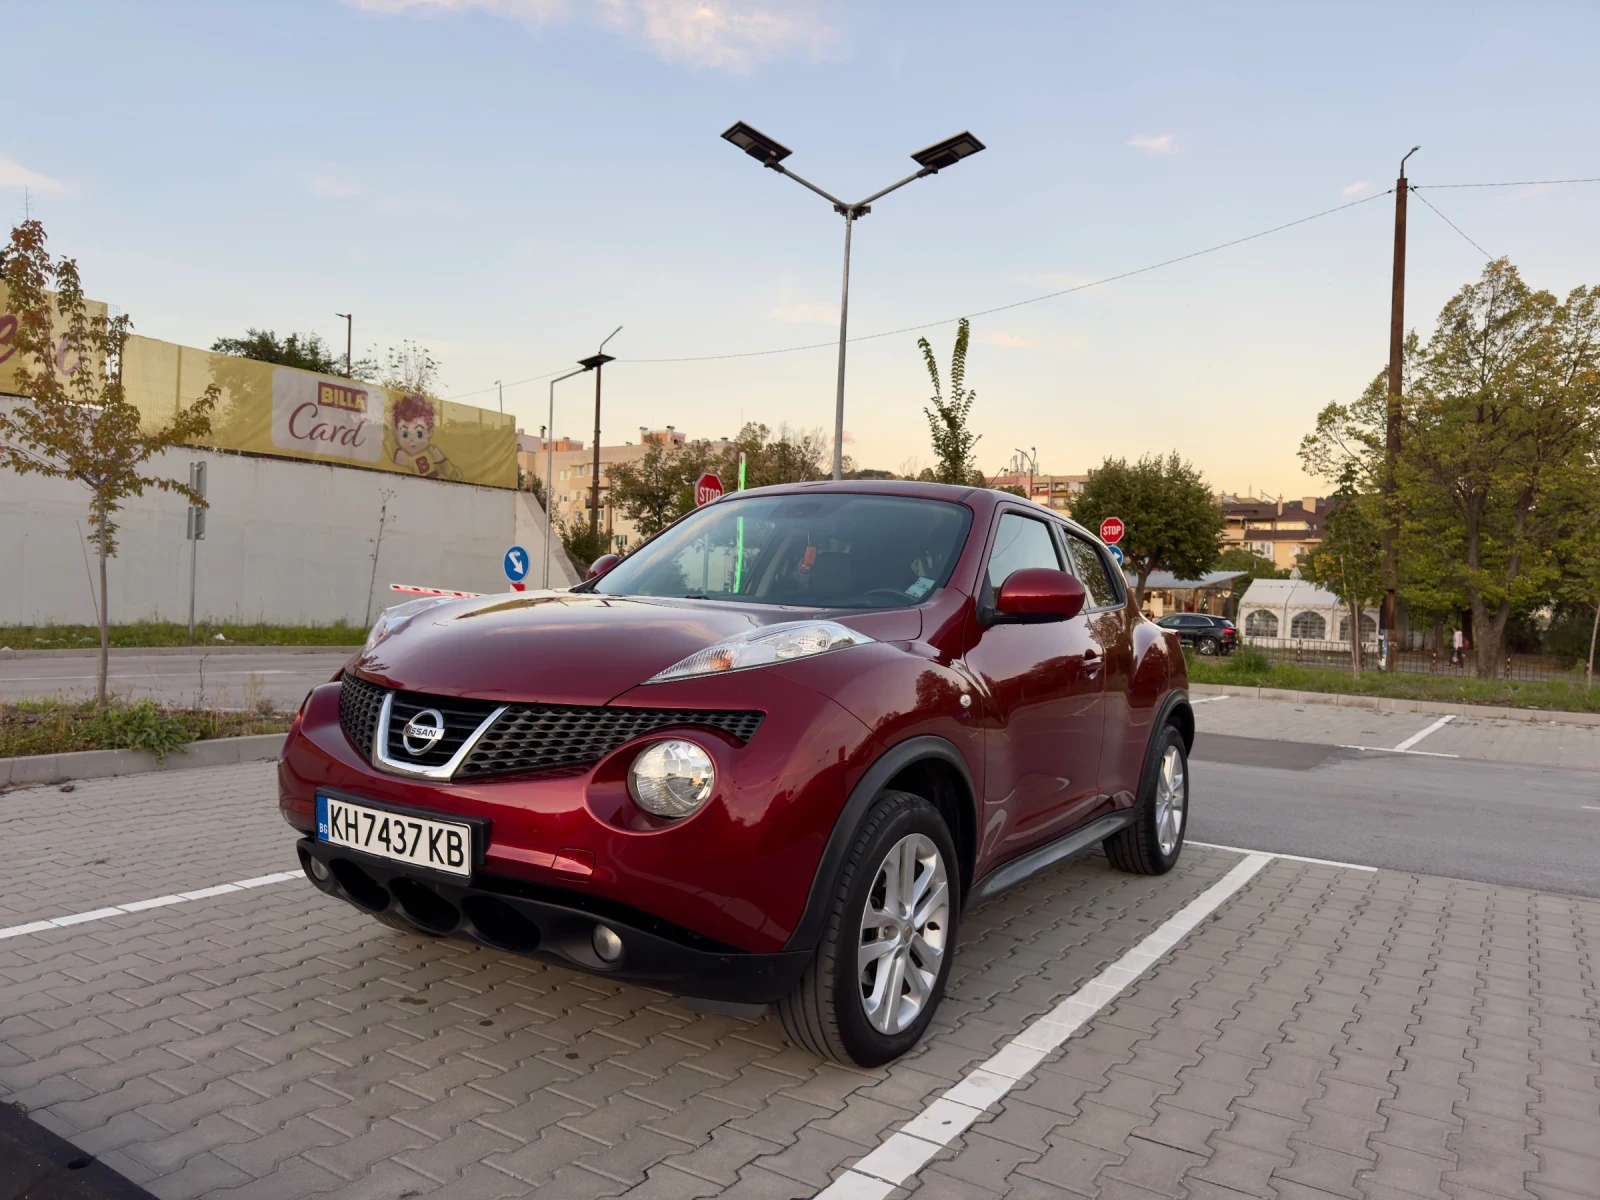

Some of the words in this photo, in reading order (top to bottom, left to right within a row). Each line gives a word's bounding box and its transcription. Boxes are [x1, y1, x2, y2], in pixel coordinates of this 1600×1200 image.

[321, 386, 366, 409] BILLA
[288, 402, 366, 447] Card
[1103, 526, 1121, 536] STOP
[405, 725, 437, 738] NISSAN
[319, 823, 328, 834] BG
